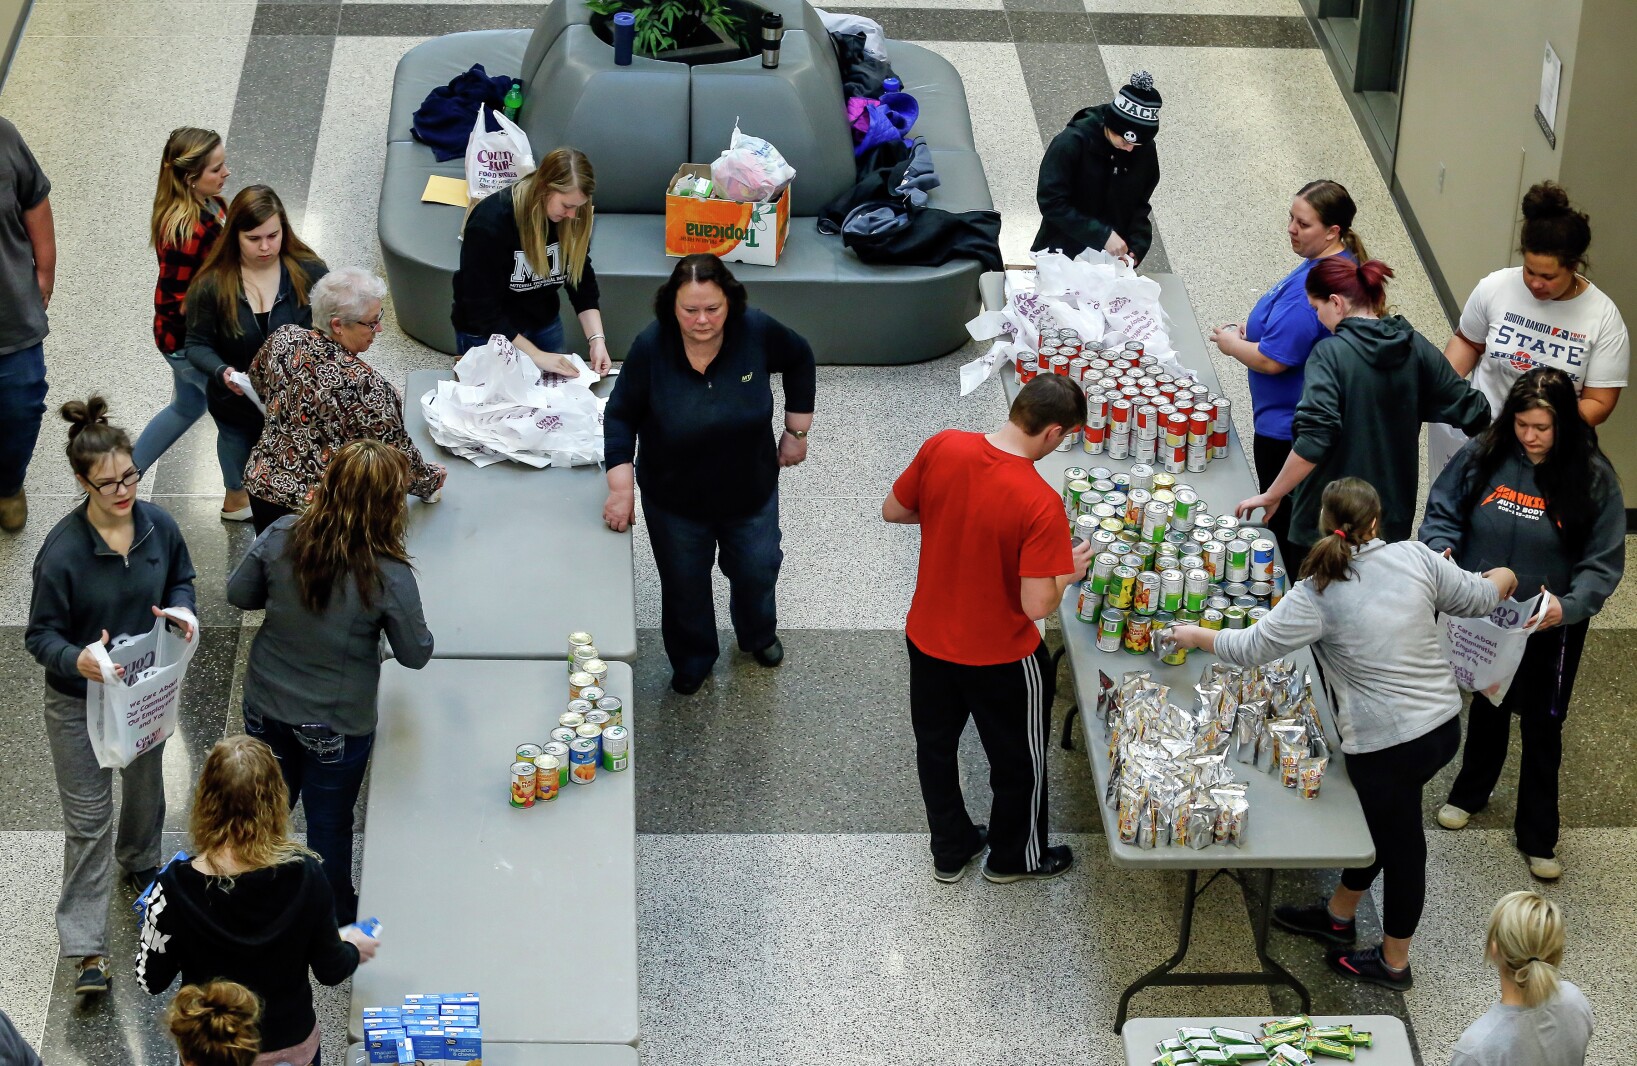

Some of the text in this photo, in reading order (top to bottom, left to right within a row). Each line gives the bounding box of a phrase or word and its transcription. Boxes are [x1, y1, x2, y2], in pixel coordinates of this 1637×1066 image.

[1119, 99, 1159, 120] JACK
[477, 150, 514, 163] COUTY
[685, 222, 760, 248] Tropicana
[1504, 312, 1526, 327] SOUTH
[1525, 319, 1552, 335] DAKOTA
[1495, 325, 1584, 366] STATE
[1481, 484, 1546, 511] HENRIKSE
[1522, 507, 1545, 517] BODY
[1453, 631, 1497, 658] Communities
[1457, 624, 1473, 637] Care
[1474, 634, 1498, 649] About
[1455, 641, 1492, 665] Employees
[129, 678, 178, 709] We Care About
[126, 711, 138, 719] Our
[127, 718, 140, 727] Our
[138, 712, 165, 729] and You
